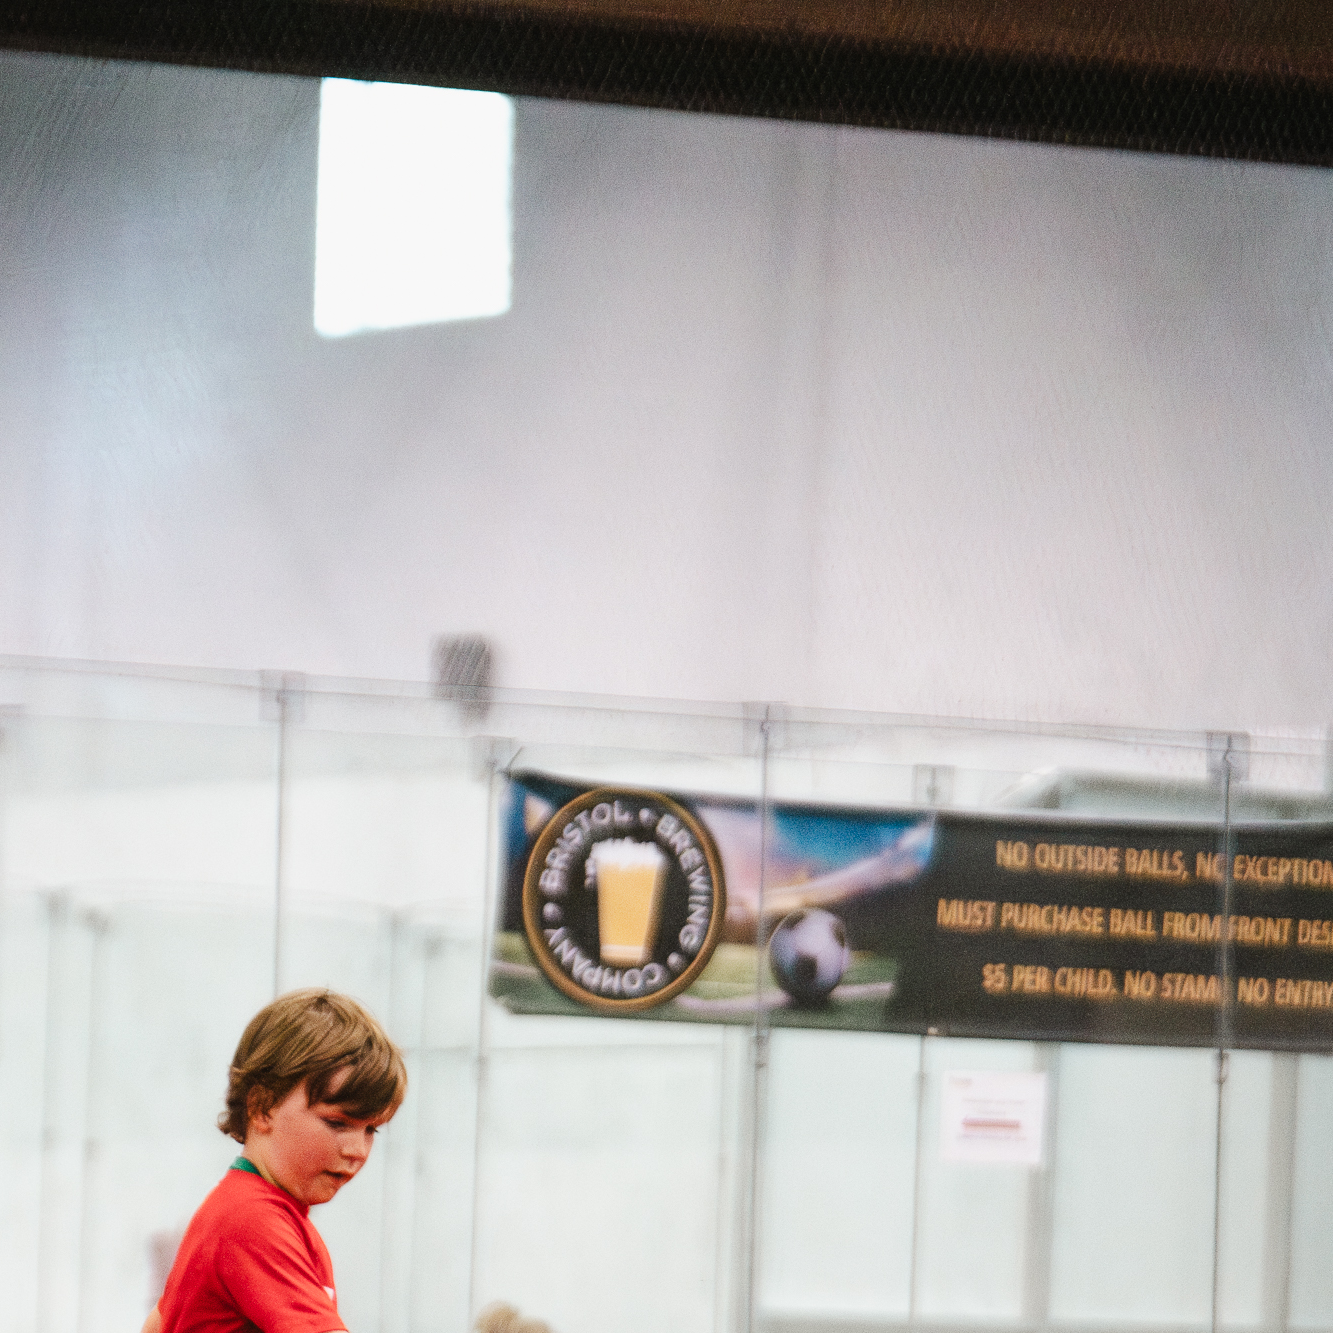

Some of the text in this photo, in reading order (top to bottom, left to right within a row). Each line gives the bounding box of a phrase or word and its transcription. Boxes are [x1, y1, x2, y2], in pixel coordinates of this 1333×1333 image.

[996, 840, 1030, 870] NO
[1035, 842, 1120, 874] OUTSIDE
[1124, 847, 1189, 880] BALLS,
[1196, 851, 1229, 881] NO
[539, 801, 709, 996] BRISTOL BREWING COMPANY
[937, 898, 1333, 947] MUST PURCHASE BALL FROM FRONT DES
[1011, 964, 1052, 994] PER
[1124, 970, 1157, 999] NO
[1237, 976, 1270, 1004] NO
